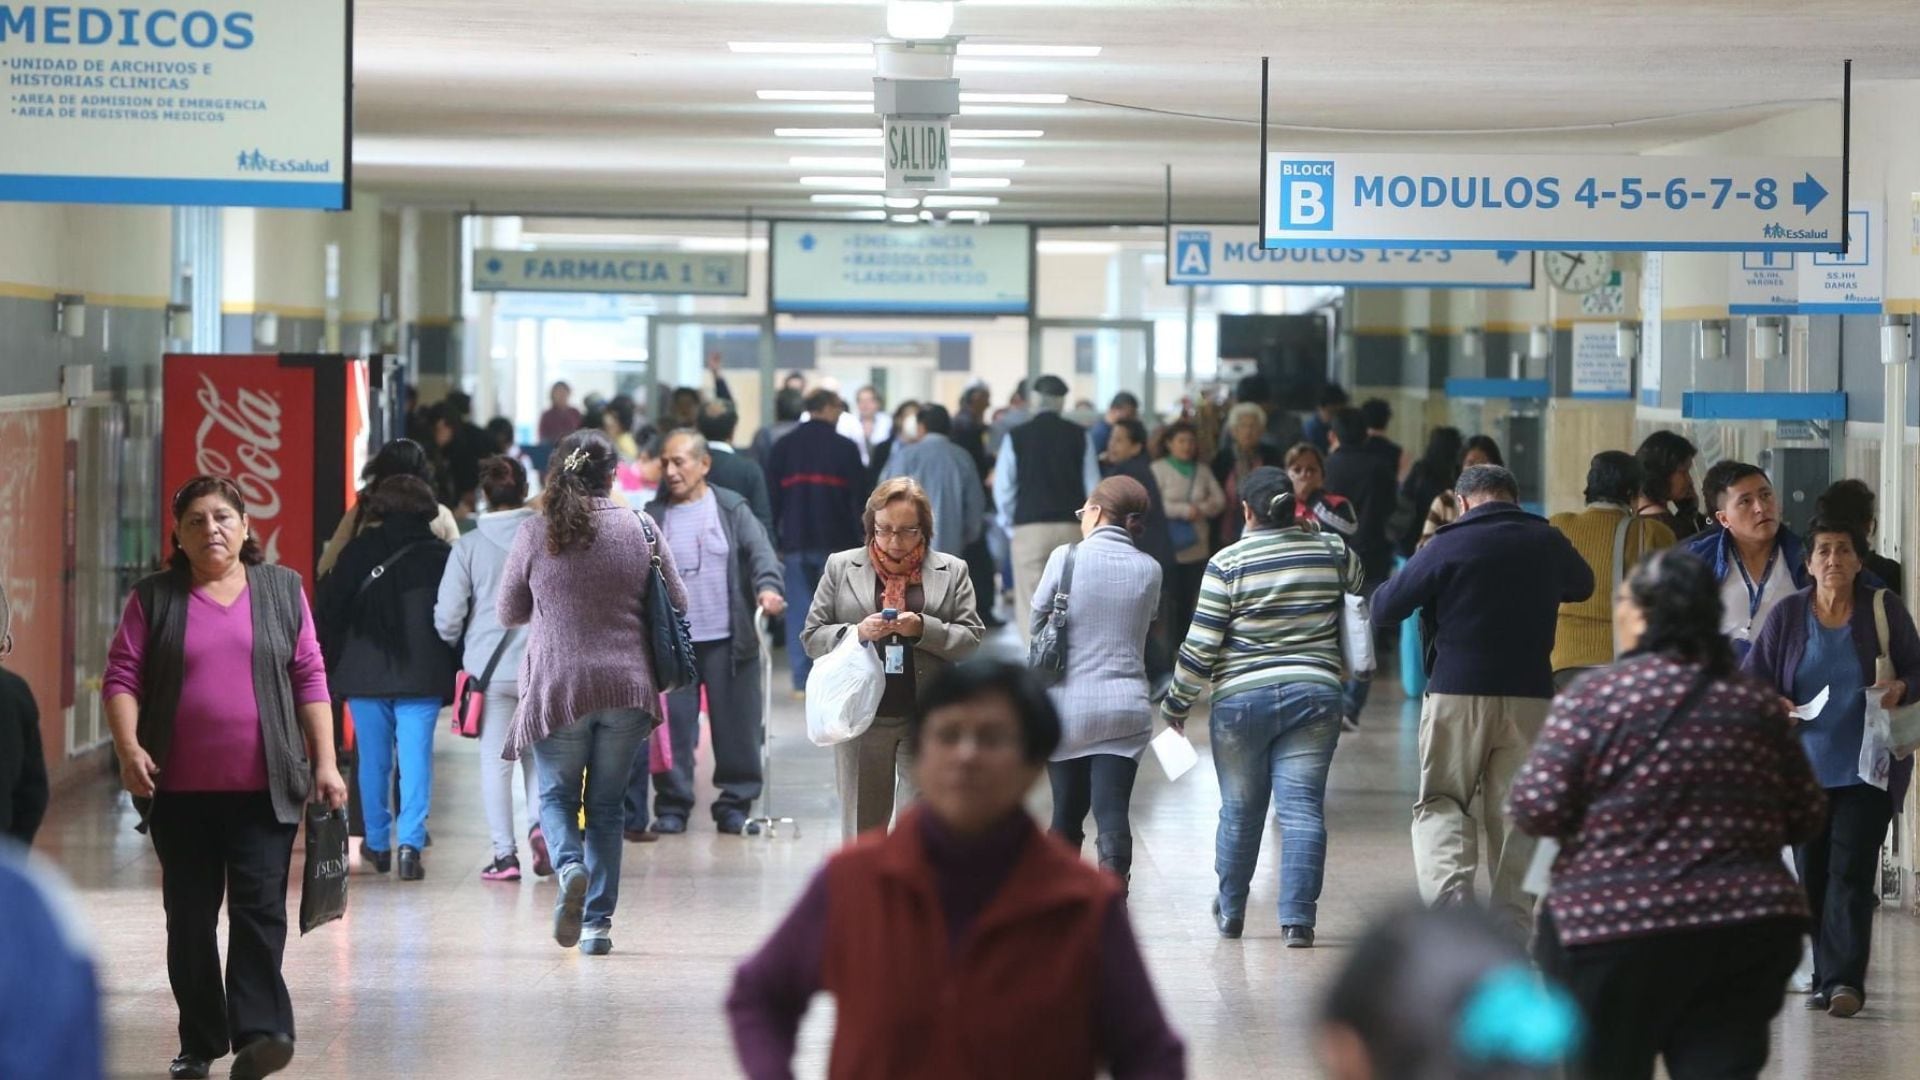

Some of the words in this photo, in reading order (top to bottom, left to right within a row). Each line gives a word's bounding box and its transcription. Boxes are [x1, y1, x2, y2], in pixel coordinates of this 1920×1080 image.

[0, 5, 254, 50] MEDICOS
[10, 57, 78, 72] UNIDAD
[83, 59, 104, 73] DE
[110, 60, 197, 75] ARCHIVOS
[203, 62, 213, 75] E
[10, 73, 104, 88] HISTORIAS
[109, 75, 189, 91] CLINICAS
[19, 93, 54, 106] AREA
[59, 94, 76, 106] DE
[81, 96, 152, 108] ADMISION
[157, 98, 174, 109] DE
[179, 98, 267, 111] EMERGENCIA
[19, 107, 54, 118] AREA
[59, 108, 75, 119] DE
[81, 109, 158, 121] REGISTROS
[163, 110, 225, 122] MEDICOS
[889, 125, 948, 171] SALIDA
[270, 158, 329, 173] EsSalud
[1283, 163, 1332, 177] BLOCK
[1354, 175, 1560, 209] MODULOS
[1574, 177, 1778, 210] 4-5-6-7-8
[1290, 181, 1326, 225] B
[1786, 228, 1828, 239] EsSalud
[1180, 243, 1208, 273] A
[1223, 242, 1366, 262] MODULOS
[1377, 248, 1452, 262] 1-2-3
[524, 258, 669, 282] FARMACIA
[681, 264, 692, 282] 1
[1825, 281, 1858, 289] DAMAS
